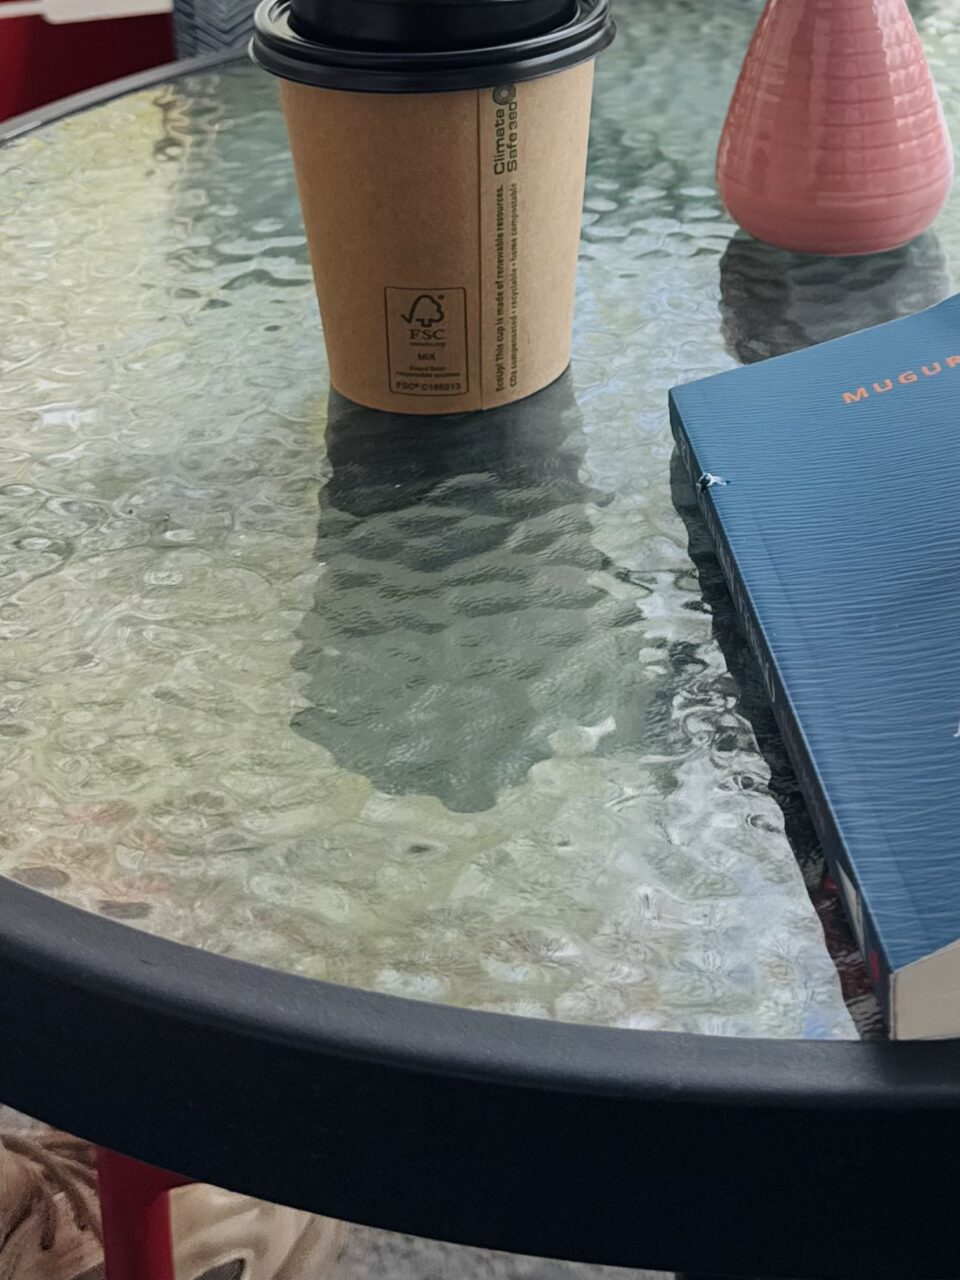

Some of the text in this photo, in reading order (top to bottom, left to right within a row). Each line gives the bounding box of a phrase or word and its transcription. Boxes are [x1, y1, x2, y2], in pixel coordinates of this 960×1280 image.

[493, 108, 505, 175] Climate
[496, 183, 504, 231] resources.
[509, 183, 519, 236] compostable
[495, 232, 504, 279] renewable
[510, 237, 518, 262] home
[495, 280, 504, 290] of
[510, 268, 519, 308] recyclable
[495, 291, 504, 316] made
[409, 328, 446, 340] FSC
[496, 325, 506, 342] cup
[417, 352, 437, 361] MIX
[495, 343, 504, 362] This
